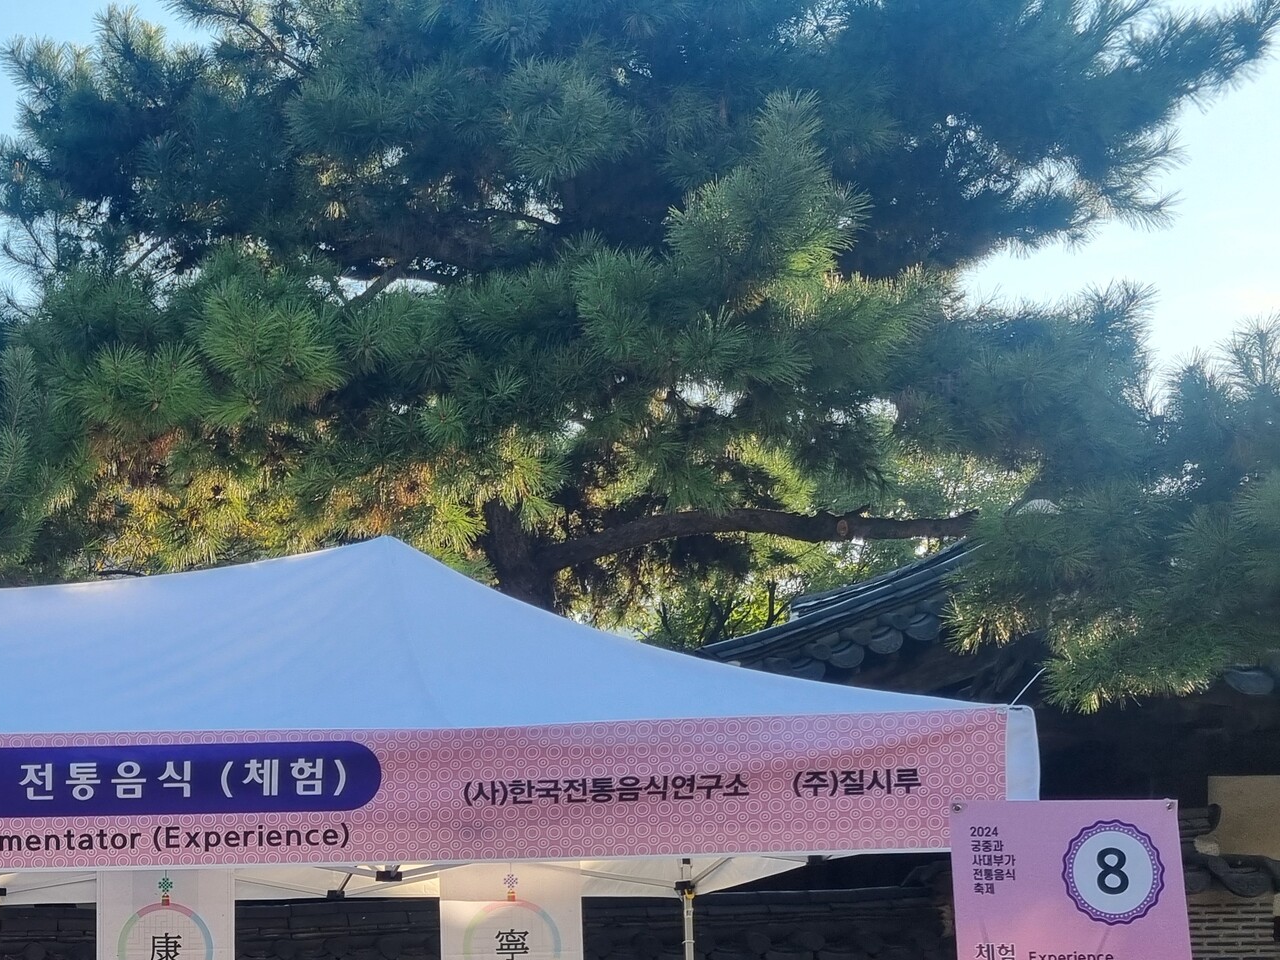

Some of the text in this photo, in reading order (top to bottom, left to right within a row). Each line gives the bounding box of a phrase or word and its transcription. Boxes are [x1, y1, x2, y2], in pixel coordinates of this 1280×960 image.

[18, 761, 192, 801] 전통음식
[221, 758, 347, 798] (체험)
[463, 768, 921, 806] (사)한국전통음식연구소 (주)질시루
[153, 823, 350, 852] (Experience)
[970, 827, 999, 837] 2024
[971, 840, 1004, 852] 궁중과
[972, 854, 1016, 866] 사대부가
[973, 869, 1016, 881] 전통음식
[1097, 847, 1129, 895] 8
[974, 883, 995, 894] 축제
